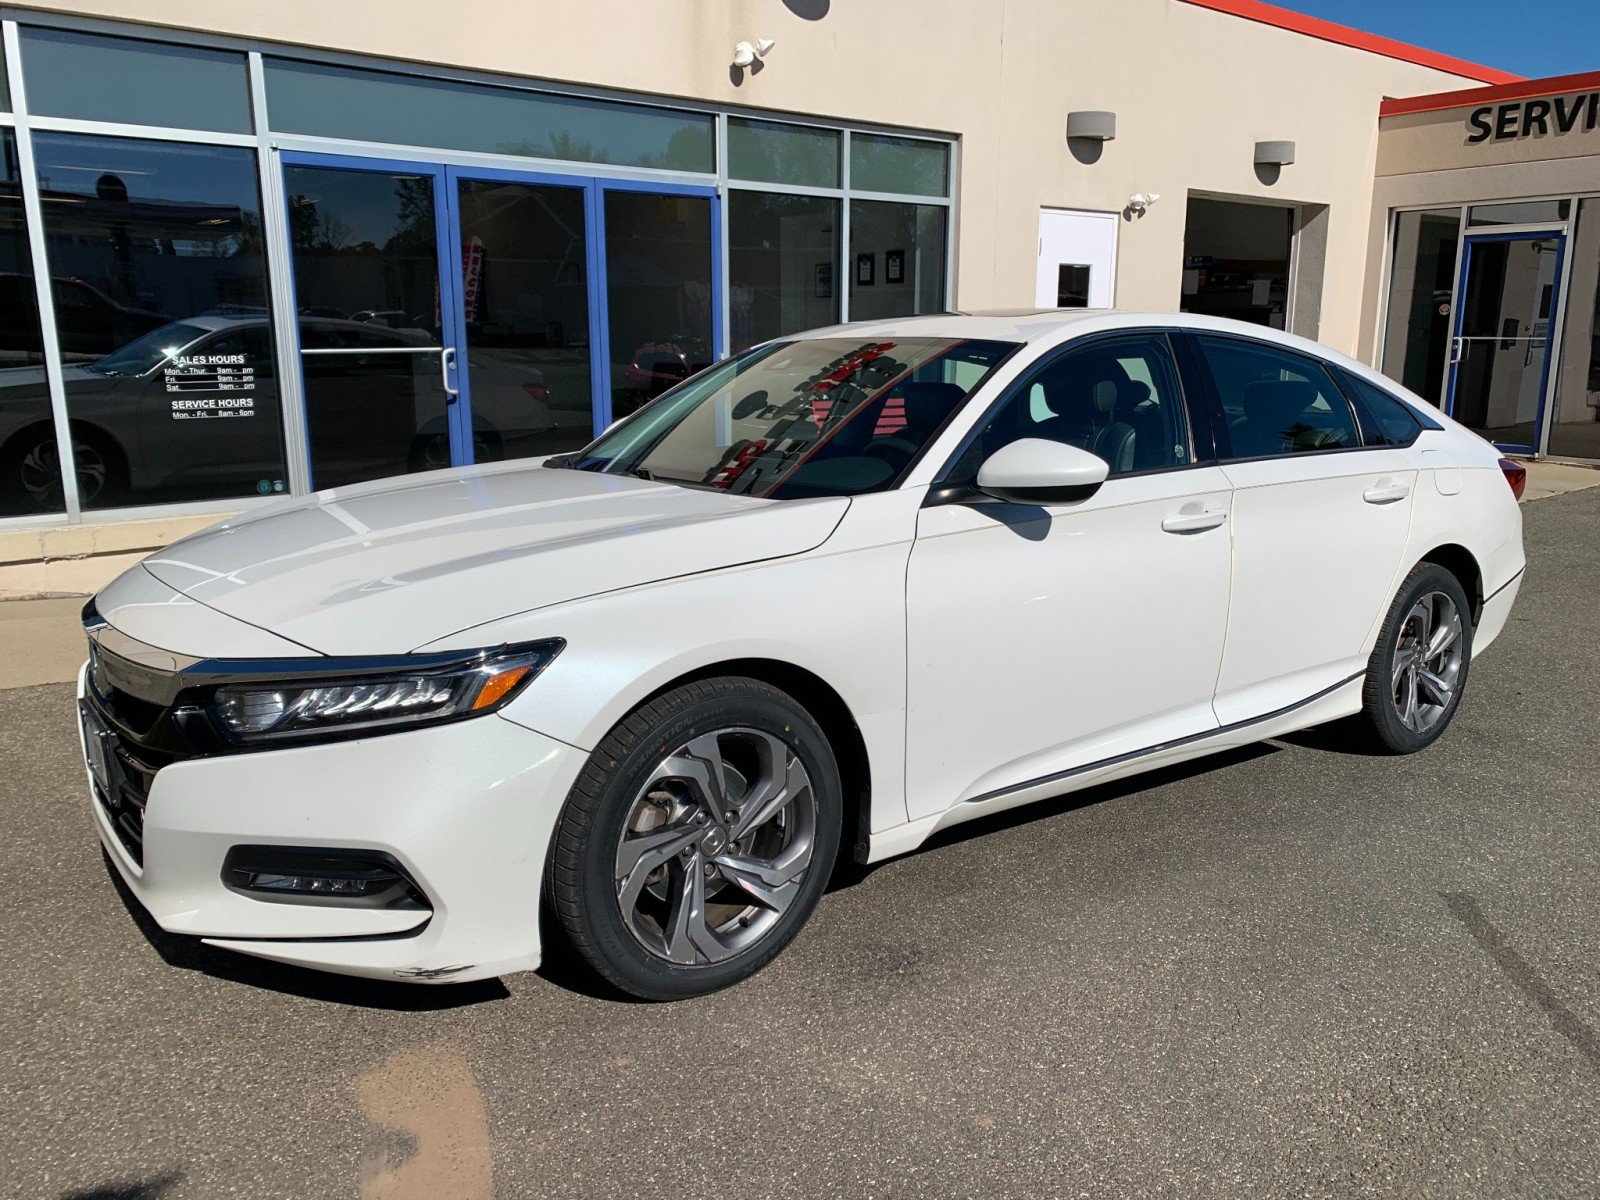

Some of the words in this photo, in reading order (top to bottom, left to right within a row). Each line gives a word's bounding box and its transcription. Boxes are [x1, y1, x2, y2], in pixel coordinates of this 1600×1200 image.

[1468, 93, 1599, 142] SERVI
[172, 355, 206, 365] SALES
[208, 355, 245, 364] HOURS
[171, 399, 216, 409] SERVICE
[218, 398, 253, 407] HOURS
[172, 411, 190, 419] Mon.
